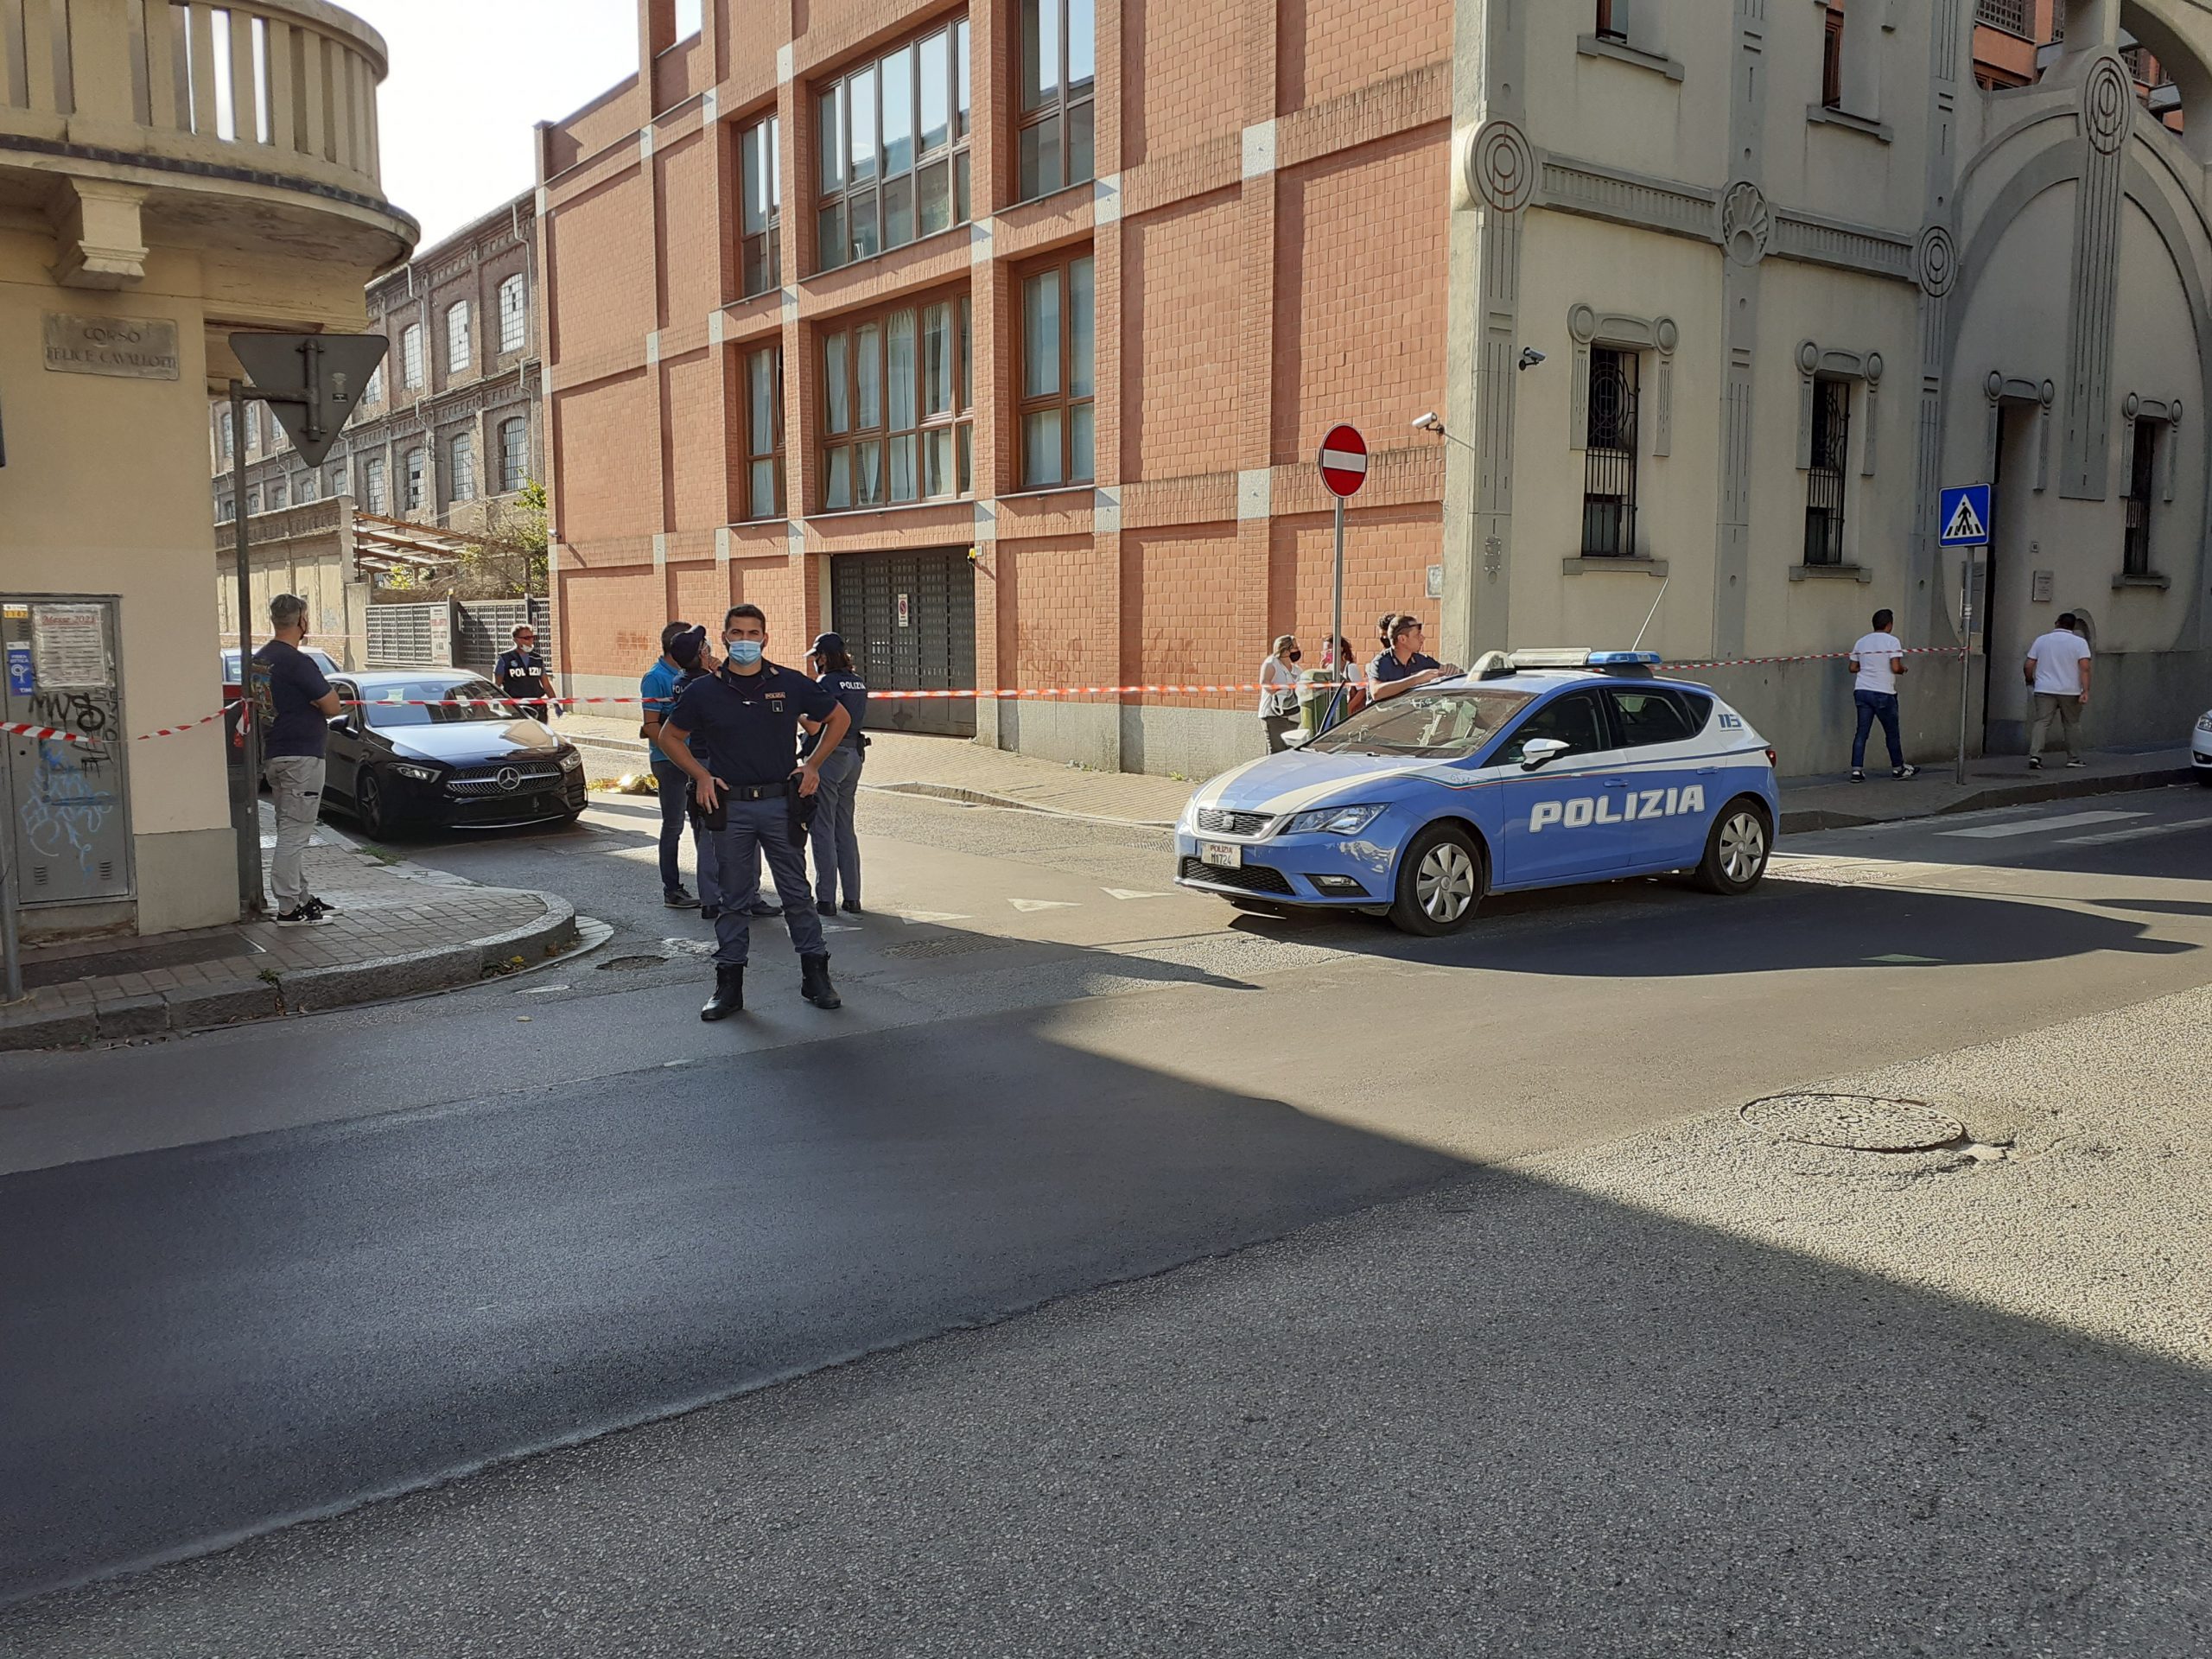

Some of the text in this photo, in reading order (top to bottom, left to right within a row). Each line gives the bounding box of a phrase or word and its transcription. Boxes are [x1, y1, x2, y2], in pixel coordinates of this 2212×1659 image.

[83, 327, 141, 343] CORSO
[46, 346, 94, 363] FELICE
[839, 681, 867, 690] POLIZIA
[1717, 714, 1743, 728] 113
[1529, 784, 1706, 834] POLIZIA
[1210, 844, 1233, 853] POLIZIA
